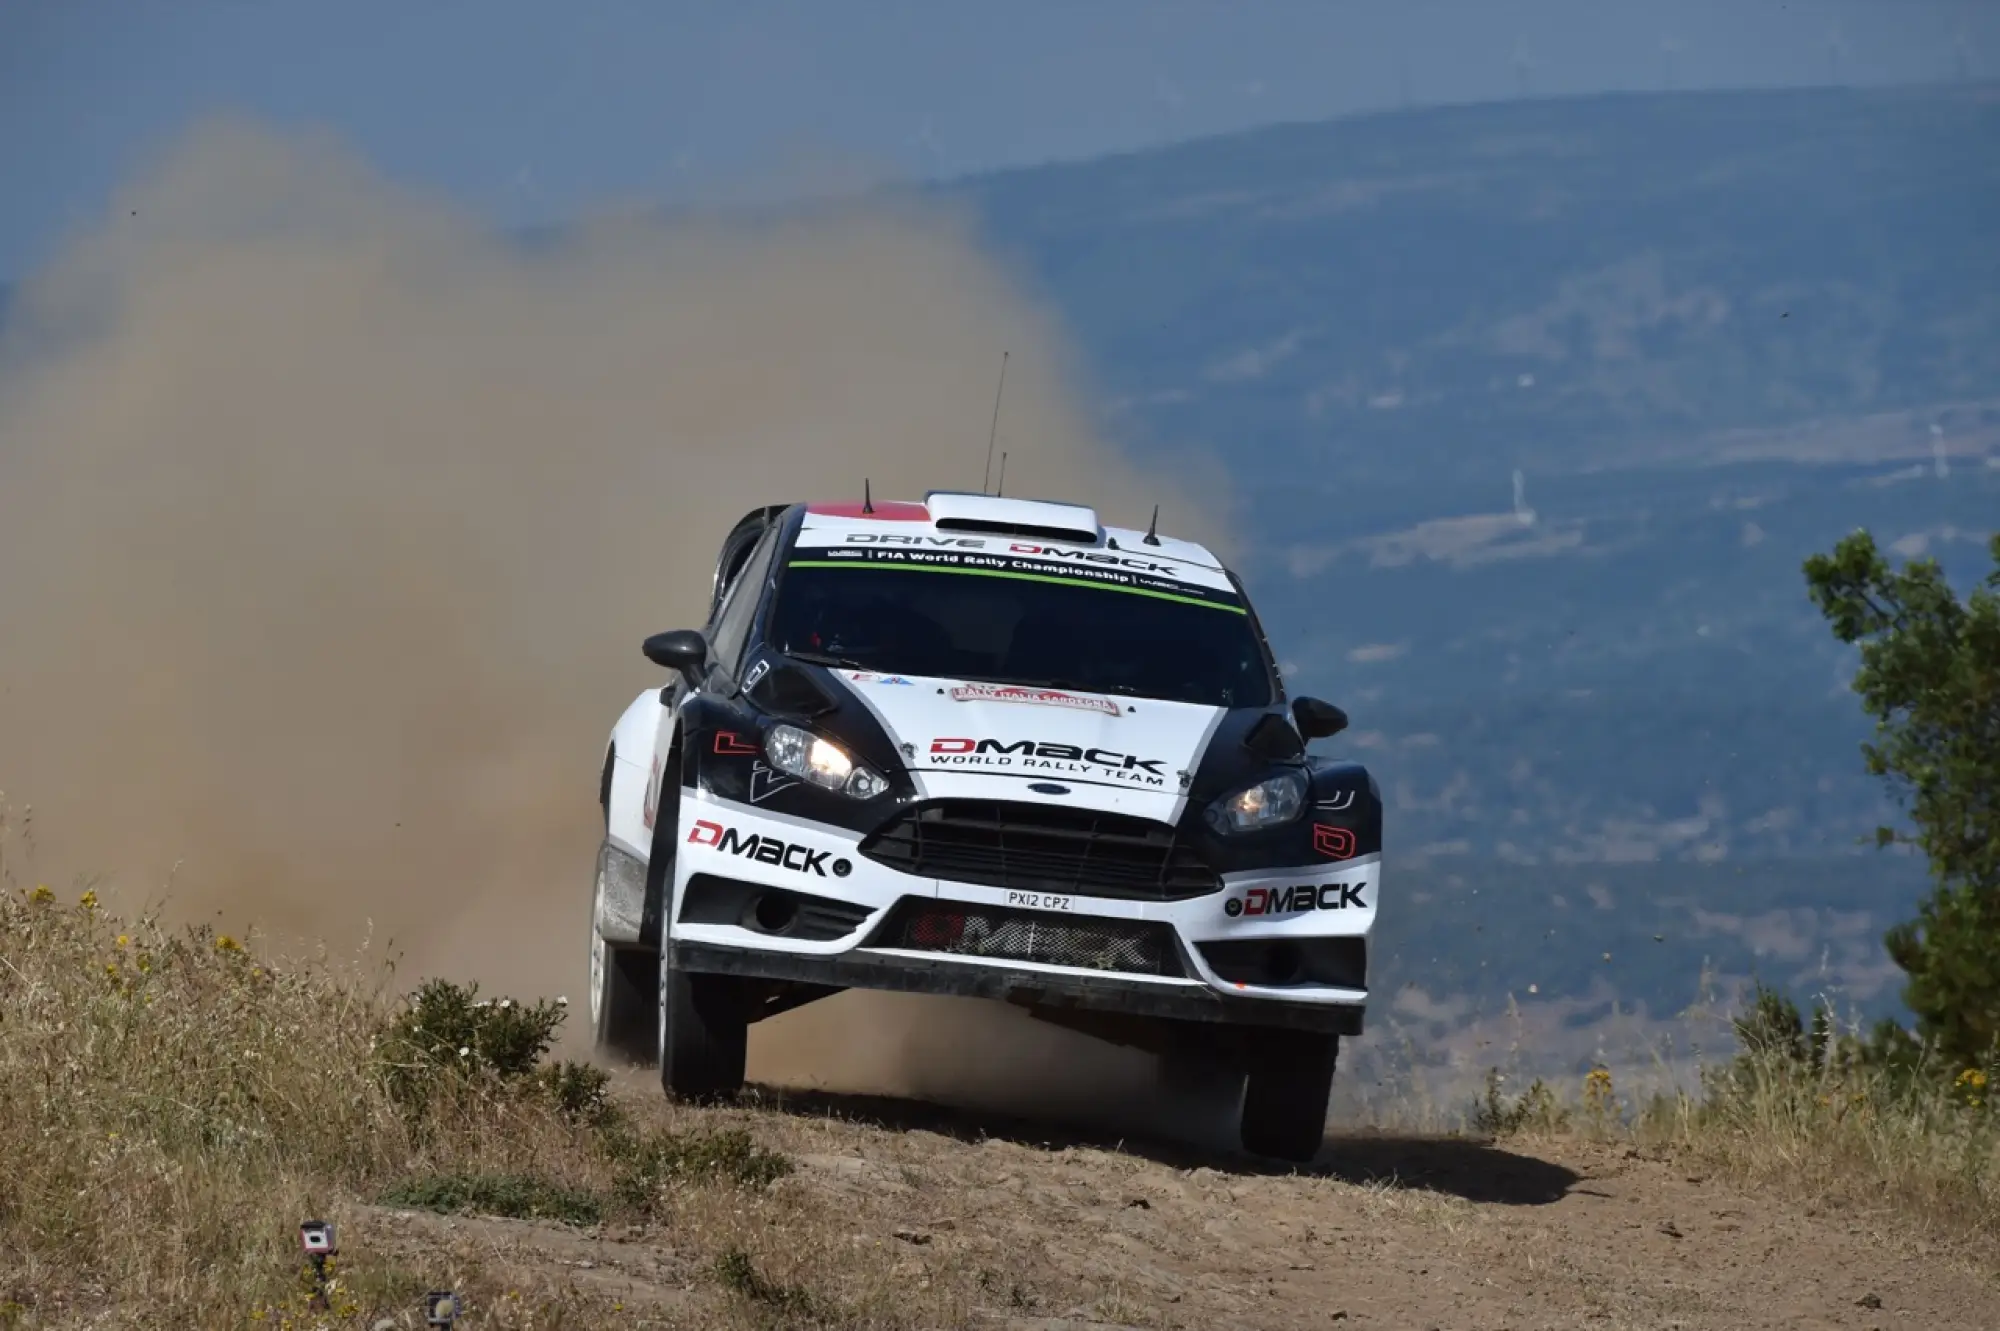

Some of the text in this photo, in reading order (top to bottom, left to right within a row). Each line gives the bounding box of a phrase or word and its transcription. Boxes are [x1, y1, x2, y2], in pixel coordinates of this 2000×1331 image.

[845, 533, 986, 549] DRIVE
[877, 551, 905, 559] FIA
[909, 552, 958, 563] World
[964, 555, 1007, 568] Rally
[1012, 560, 1129, 583] Championship
[930, 755, 1165, 787] WORLD RALLY TEAM
[1008, 891, 1070, 910] PX12 CPZ
